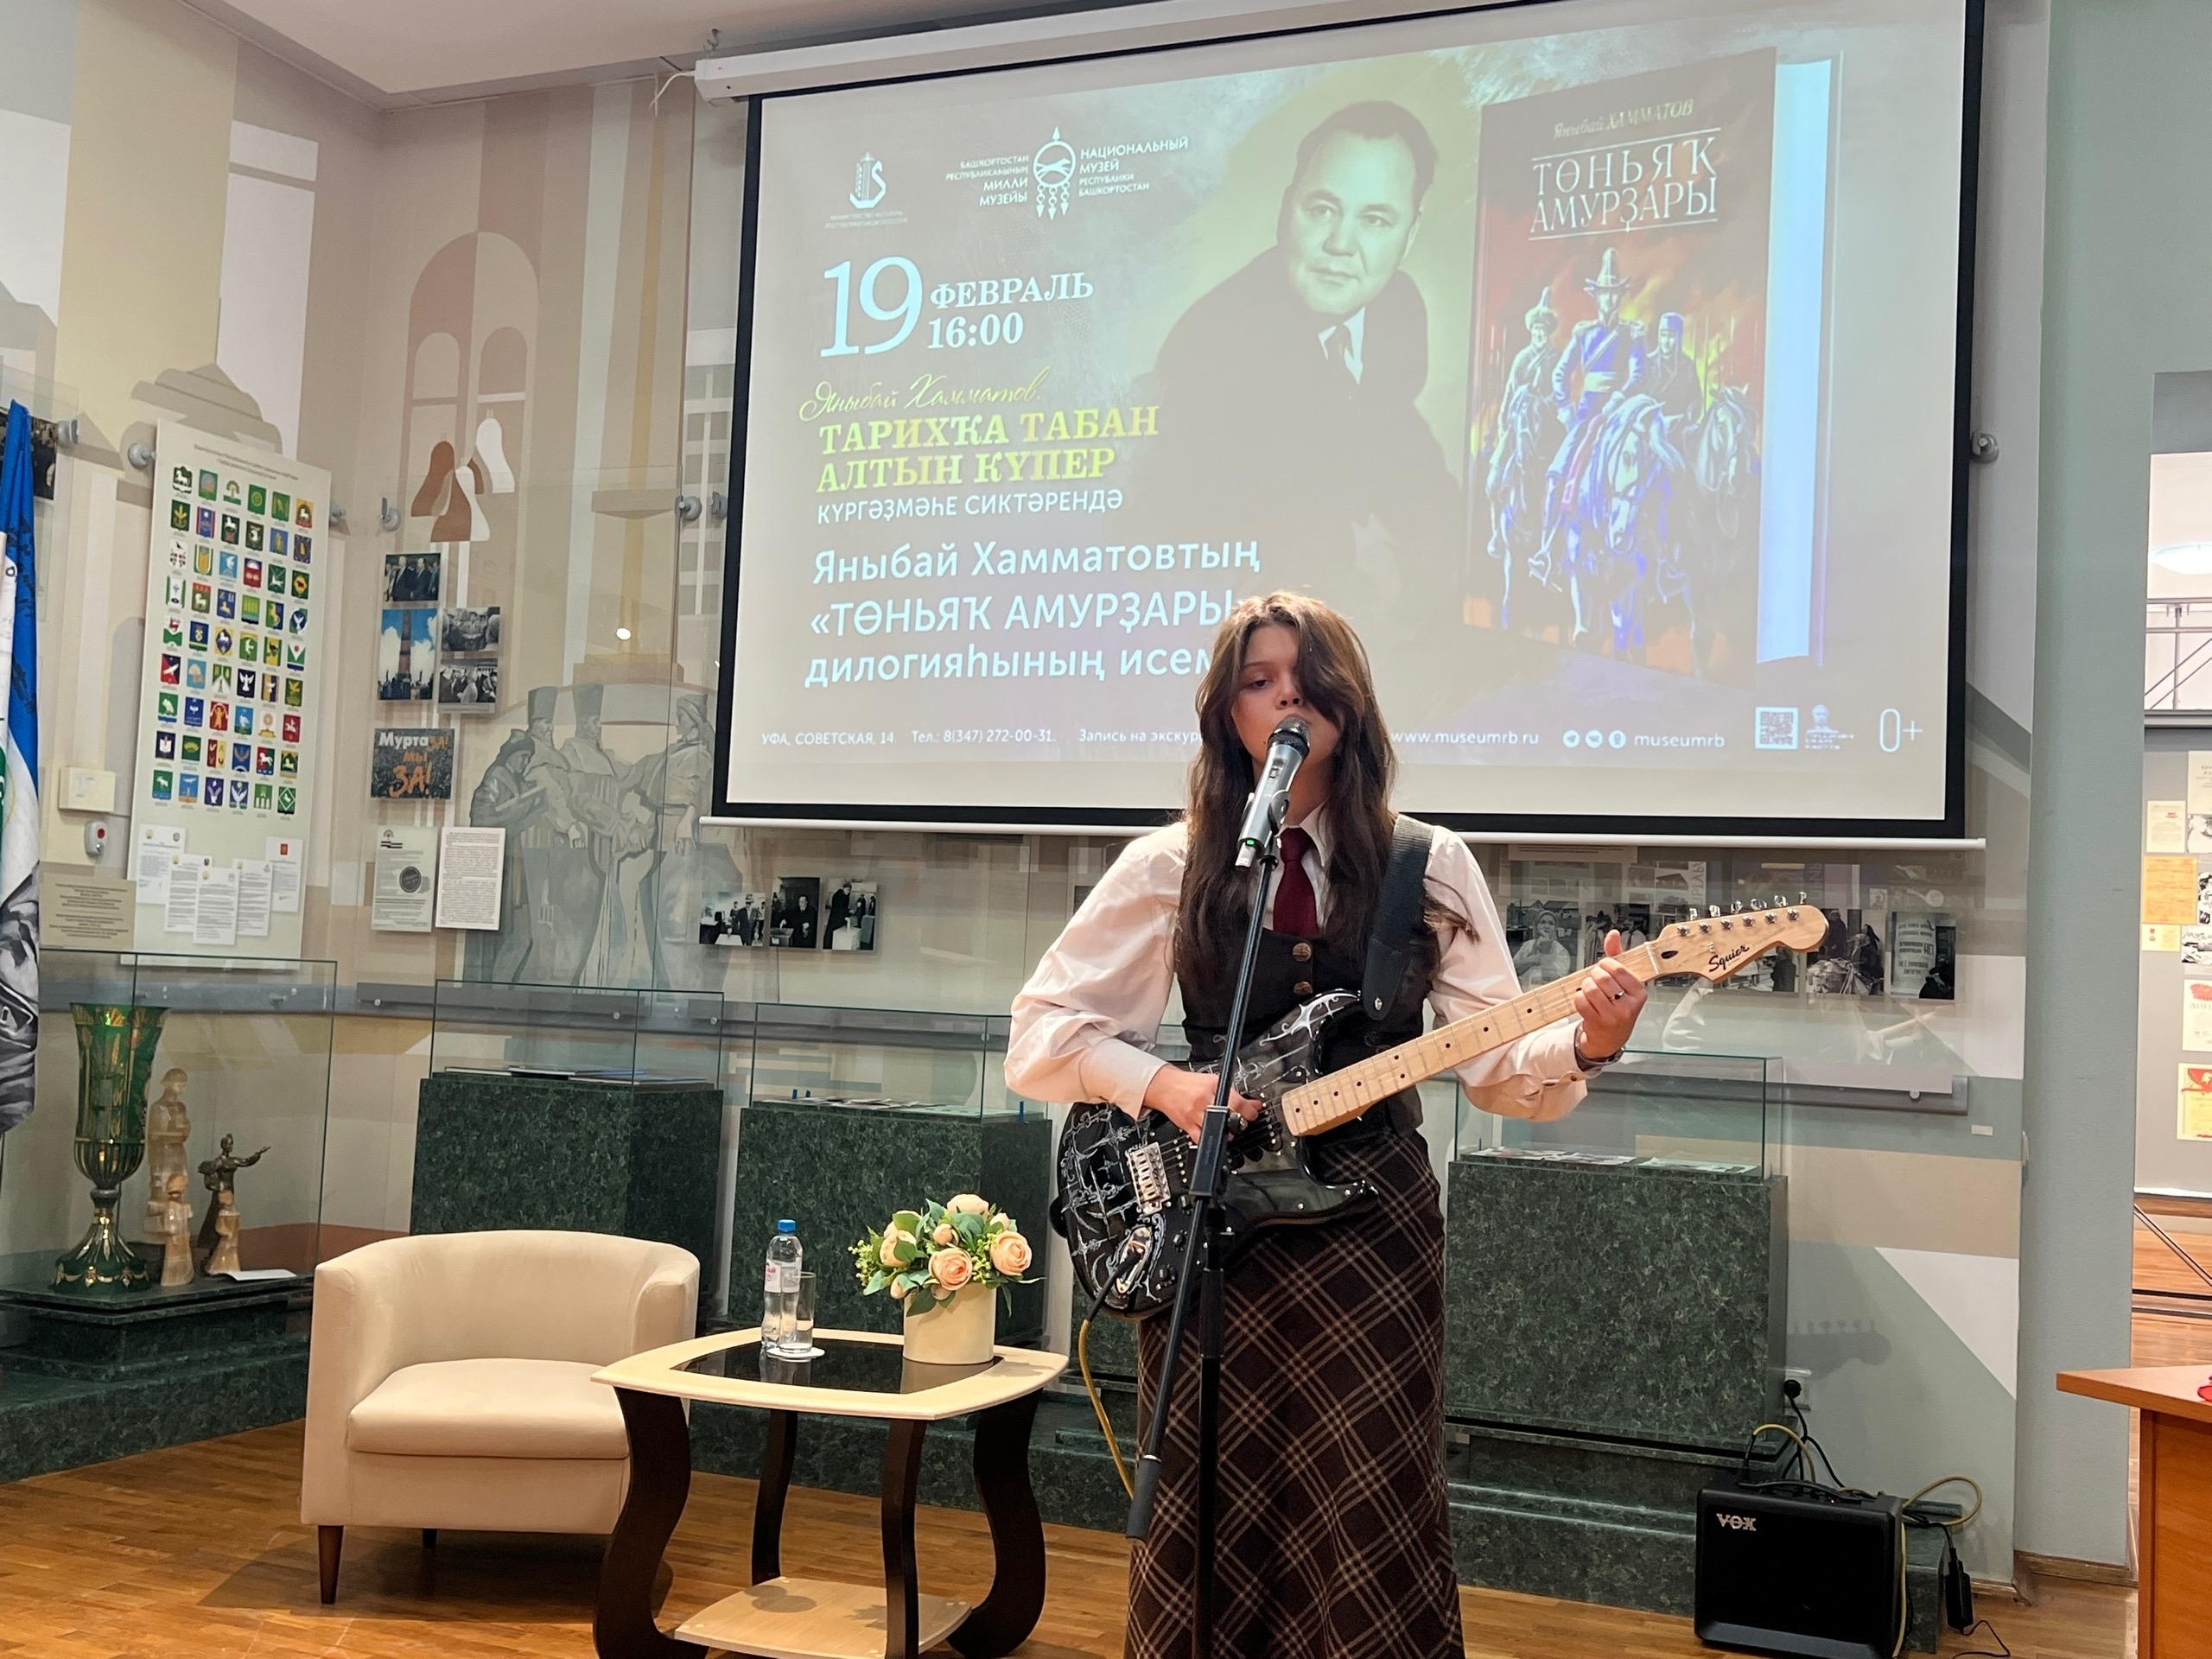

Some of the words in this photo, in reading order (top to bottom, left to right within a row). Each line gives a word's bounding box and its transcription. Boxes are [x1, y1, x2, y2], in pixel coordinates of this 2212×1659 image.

[1080, 136, 1189, 160] НАЦИОНАЛЬНЫЙ
[1078, 173, 1135, 187] РЕСПУБЛИКИ
[1079, 158, 1120, 175] МУЗЕЙ
[983, 176, 1028, 192] МИЛЛИ
[1078, 182, 1150, 197] БАШКОРТОСТАН
[979, 190, 1028, 207] МУЗЕЙЫ
[929, 271, 1095, 309] ФЕВРАЛЬ
[820, 256, 923, 357] 19
[927, 311, 1024, 349] 16:00
[819, 415, 1009, 455] ТАРИХҠА
[1019, 405, 1160, 442] ТАБАН
[816, 454, 963, 493] АЛТЫН
[973, 448, 1116, 484] КҮПЕР
[964, 489, 1124, 517] СИКТӘРЕНДӘ
[812, 542, 959, 585] Яныбай
[970, 540, 1261, 577] Хамматовтың
[810, 594, 994, 638] «ТӨНЬЯҠ
[1003, 588, 1243, 635] АМУРҘАРЫ
[804, 643, 1106, 690] дилогияһының
[761, 732, 791, 746] УФА,
[795, 732, 876, 747] СОВЕТСКАЯ,
[943, 728, 983, 743] 8(347)
[1079, 728, 1127, 743] Запись
[1130, 731, 1147, 742] на
[1390, 729, 1539, 746] www.museumrb.ru
[1634, 733, 1726, 748] museumrb
[1879, 708, 1923, 753] 0+
[388, 760, 433, 798] ЗА!
[1708, 944, 1750, 972] Squier
[1716, 1513, 1757, 1531] VOX
